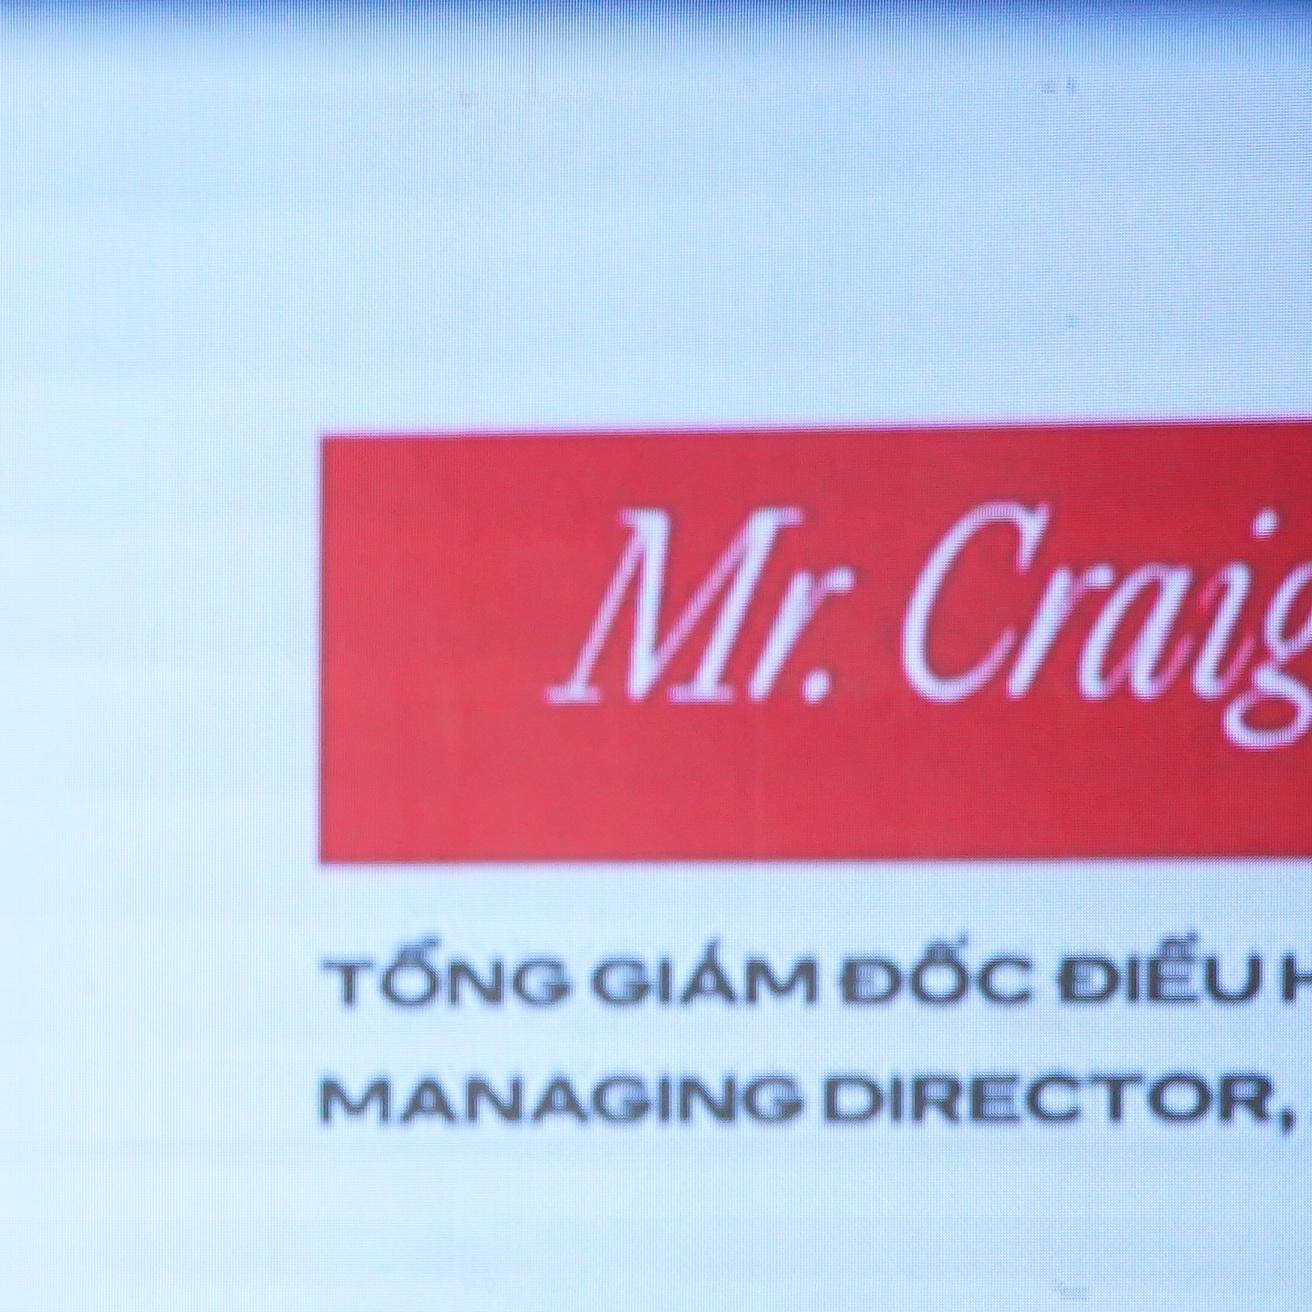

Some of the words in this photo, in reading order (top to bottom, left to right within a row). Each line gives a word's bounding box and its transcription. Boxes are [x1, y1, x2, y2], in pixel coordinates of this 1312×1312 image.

[543, 503, 855, 705] Mr.
[901, 501, 1312, 750] Craig
[590, 936, 817, 1006] GIÁM
[838, 930, 1035, 1006] ĐỐC
[318, 1072, 804, 1127] MANAGING
[823, 1071, 1297, 1136] DIRECTOR,
